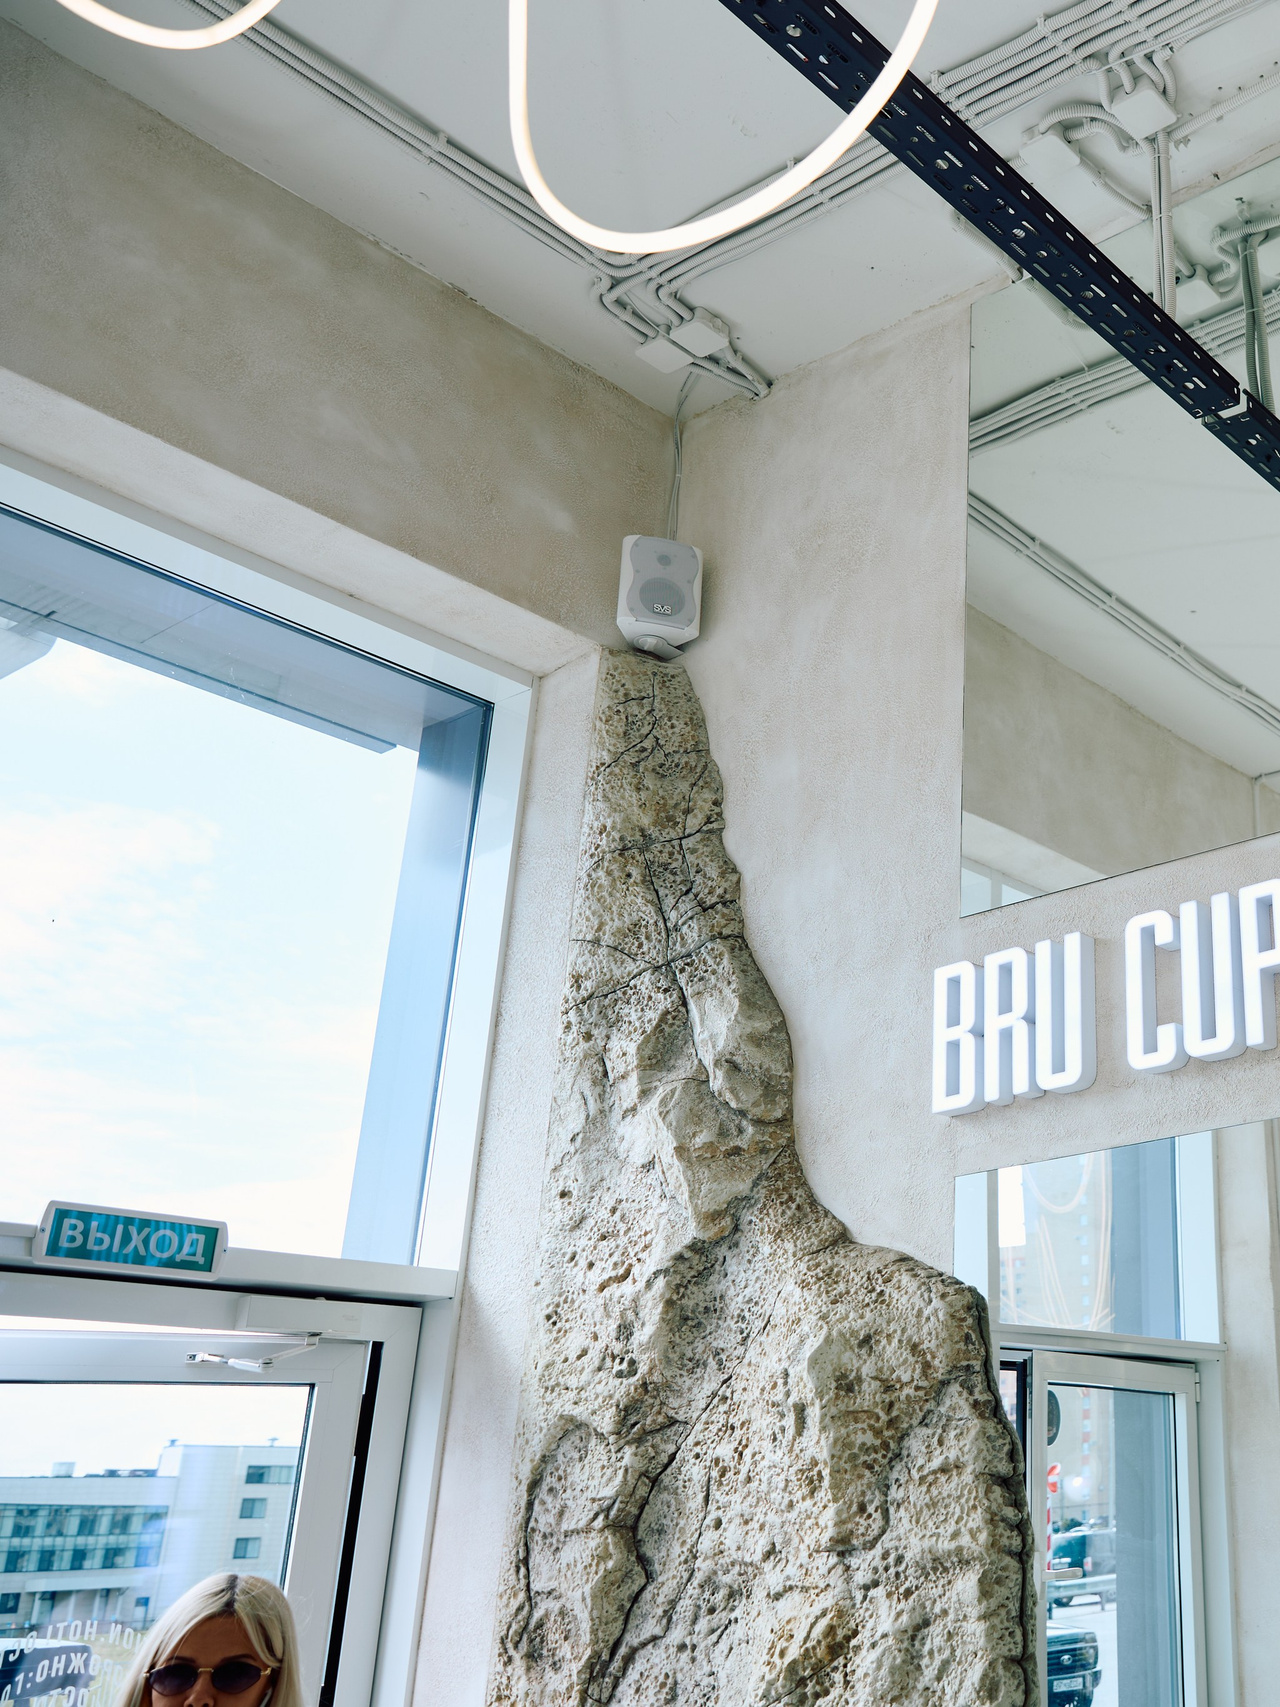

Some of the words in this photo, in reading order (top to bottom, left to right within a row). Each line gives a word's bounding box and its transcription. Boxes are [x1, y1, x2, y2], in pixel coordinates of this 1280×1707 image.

[653, 603, 671, 614] SVS
[932, 931, 1094, 1117] BRU
[58, 1217, 206, 1265] ВЫХОД
